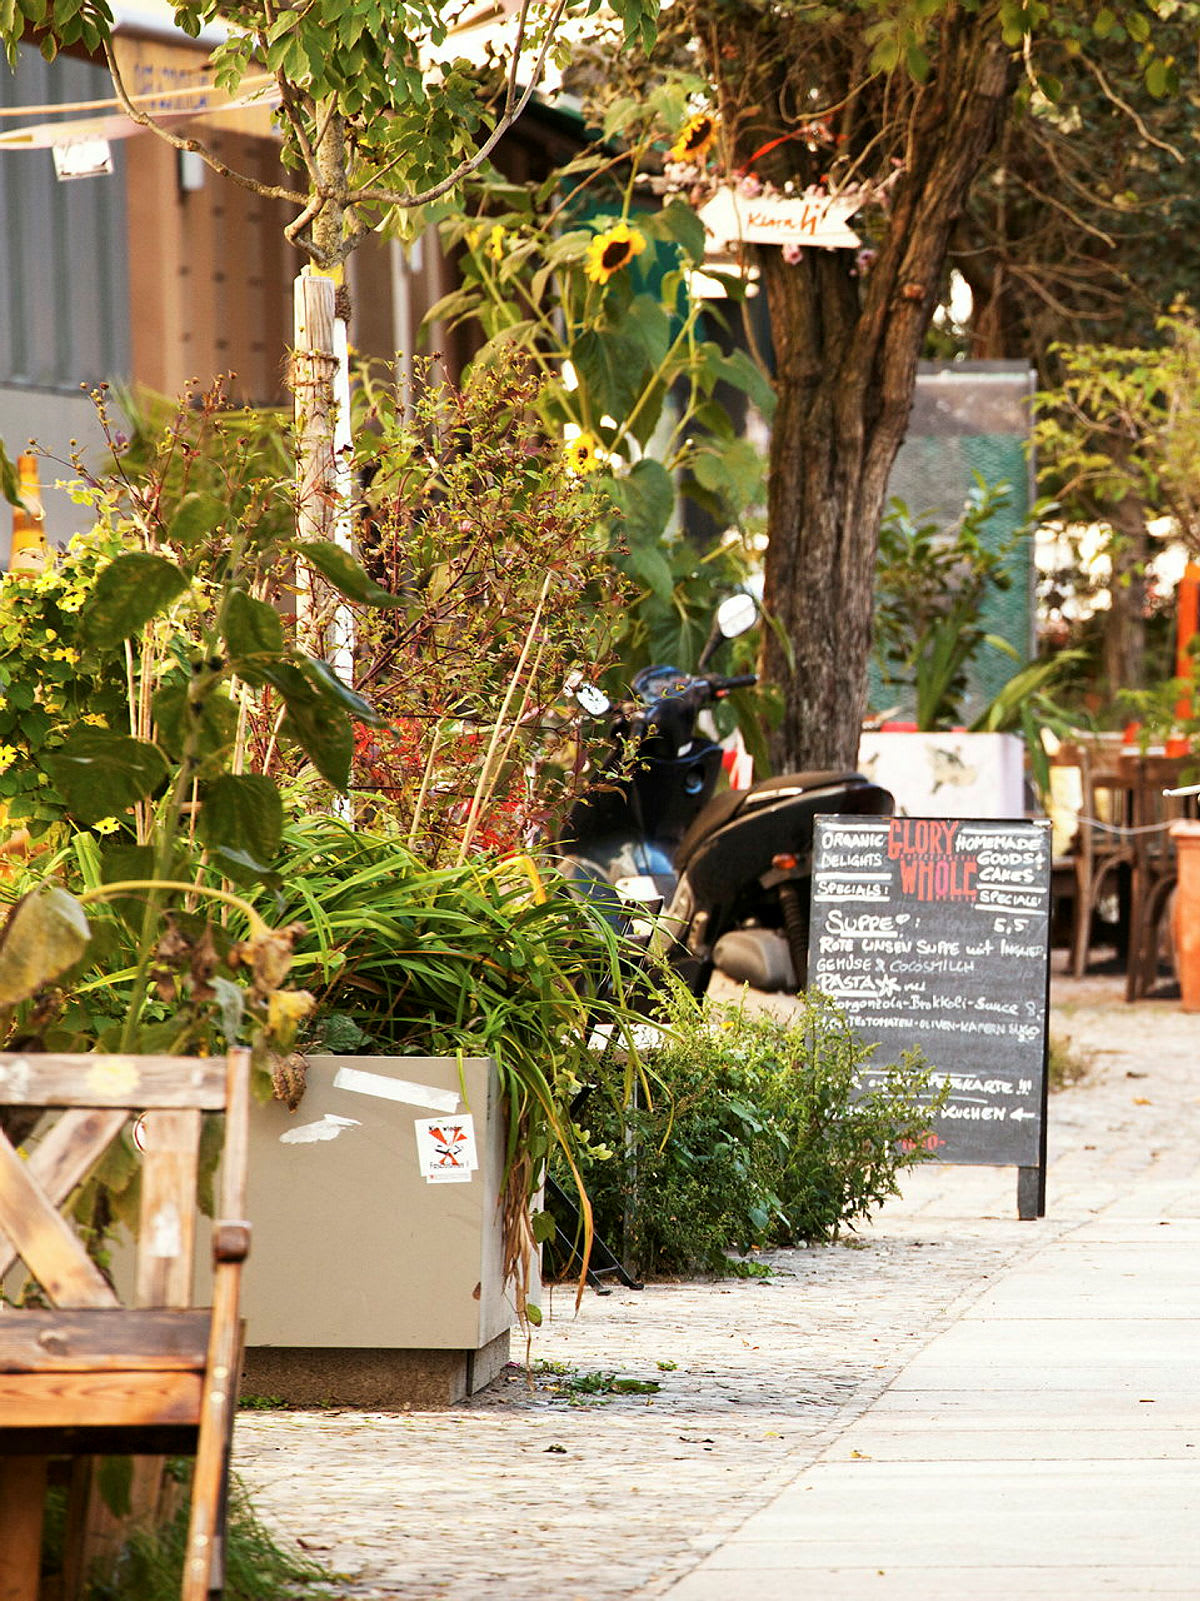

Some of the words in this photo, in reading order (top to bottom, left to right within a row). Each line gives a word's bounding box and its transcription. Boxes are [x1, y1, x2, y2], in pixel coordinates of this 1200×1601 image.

[822, 832, 884, 849] ORGANIC
[888, 819, 959, 860] GLORY
[955, 834, 1043, 853] HOMEMADE
[821, 852, 883, 869] DELIGHTS
[977, 850, 1035, 866] GOODS
[901, 860, 978, 901] WHOLE
[978, 865, 1036, 884] CAKES
[820, 936, 854, 954] ROTE
[815, 972, 877, 996] PASTA
